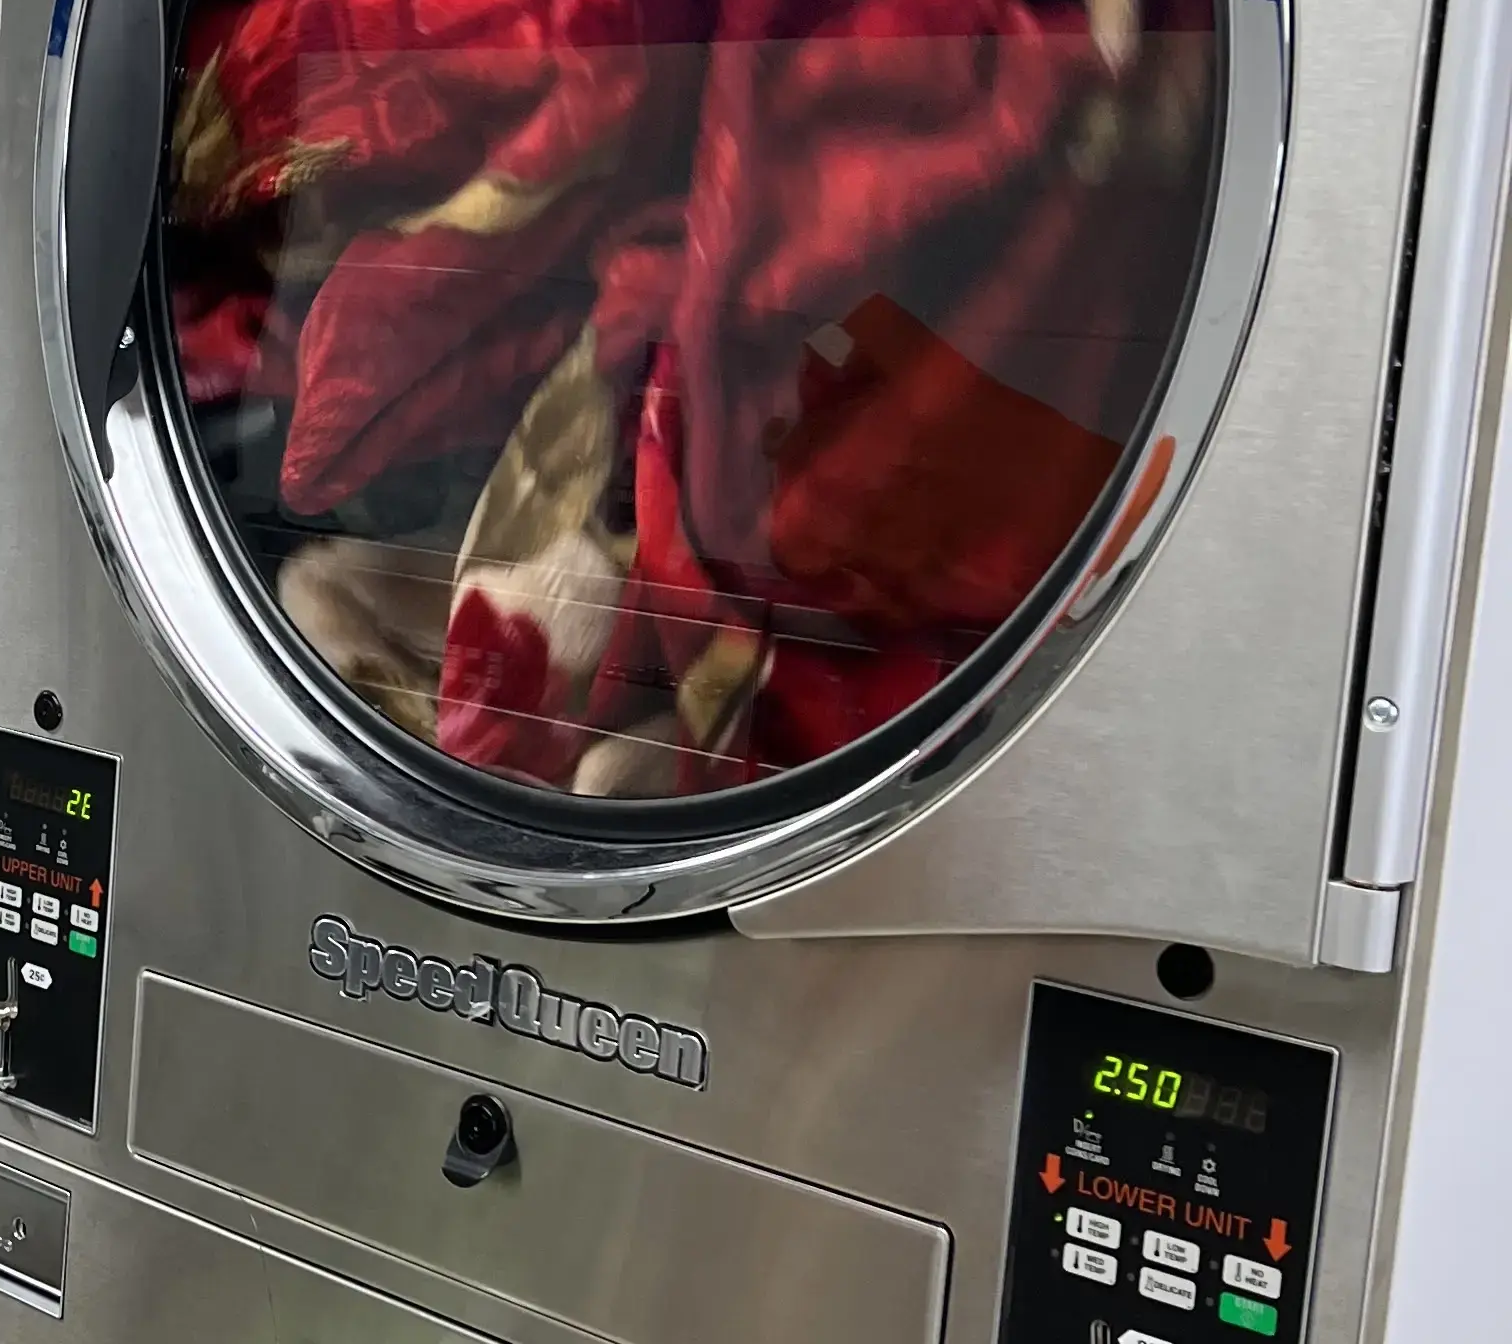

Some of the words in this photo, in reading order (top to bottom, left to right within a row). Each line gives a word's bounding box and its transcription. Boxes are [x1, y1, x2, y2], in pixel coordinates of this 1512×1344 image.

[2, 856, 47, 884] UPPER
[51, 869, 83, 893] UNIT
[308, 913, 498, 1026] Speed
[497, 963, 709, 1091] Queen
[1094, 1055, 1182, 1108] 2.50
[1078, 1171, 1177, 1221] LOWER
[1185, 1201, 1252, 1240] UNIT
[1153, 1280, 1193, 1300] DELICATE
[1244, 1275, 1269, 1289] HEAT
[1250, 1267, 1265, 1278] NO
